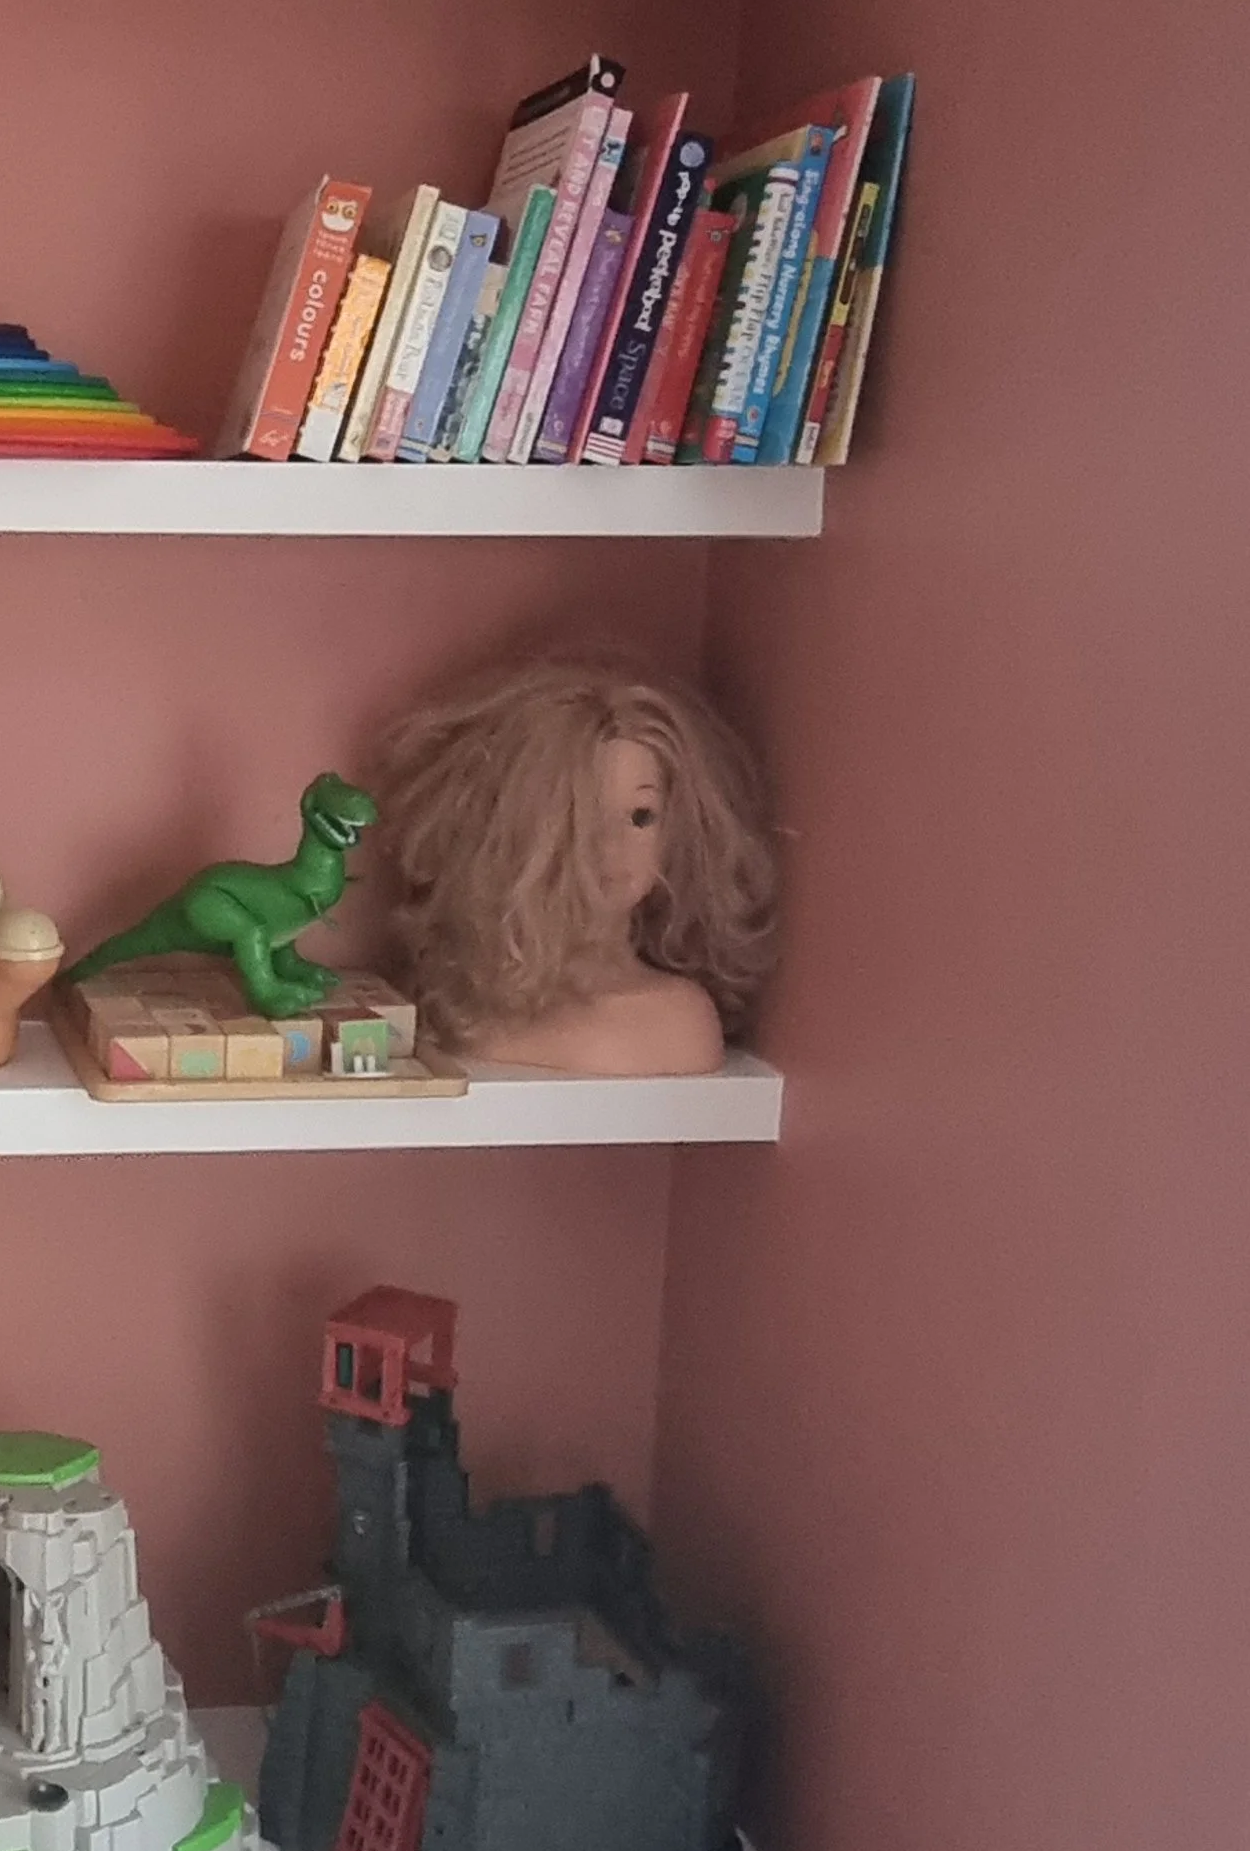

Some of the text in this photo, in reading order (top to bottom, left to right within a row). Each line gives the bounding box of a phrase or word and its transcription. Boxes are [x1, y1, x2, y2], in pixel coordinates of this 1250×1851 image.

[290, 268, 329, 363] colours
[769, 264, 794, 331] Nursery
[607, 338, 646, 410] Space
[752, 333, 780, 395] Rhymes
